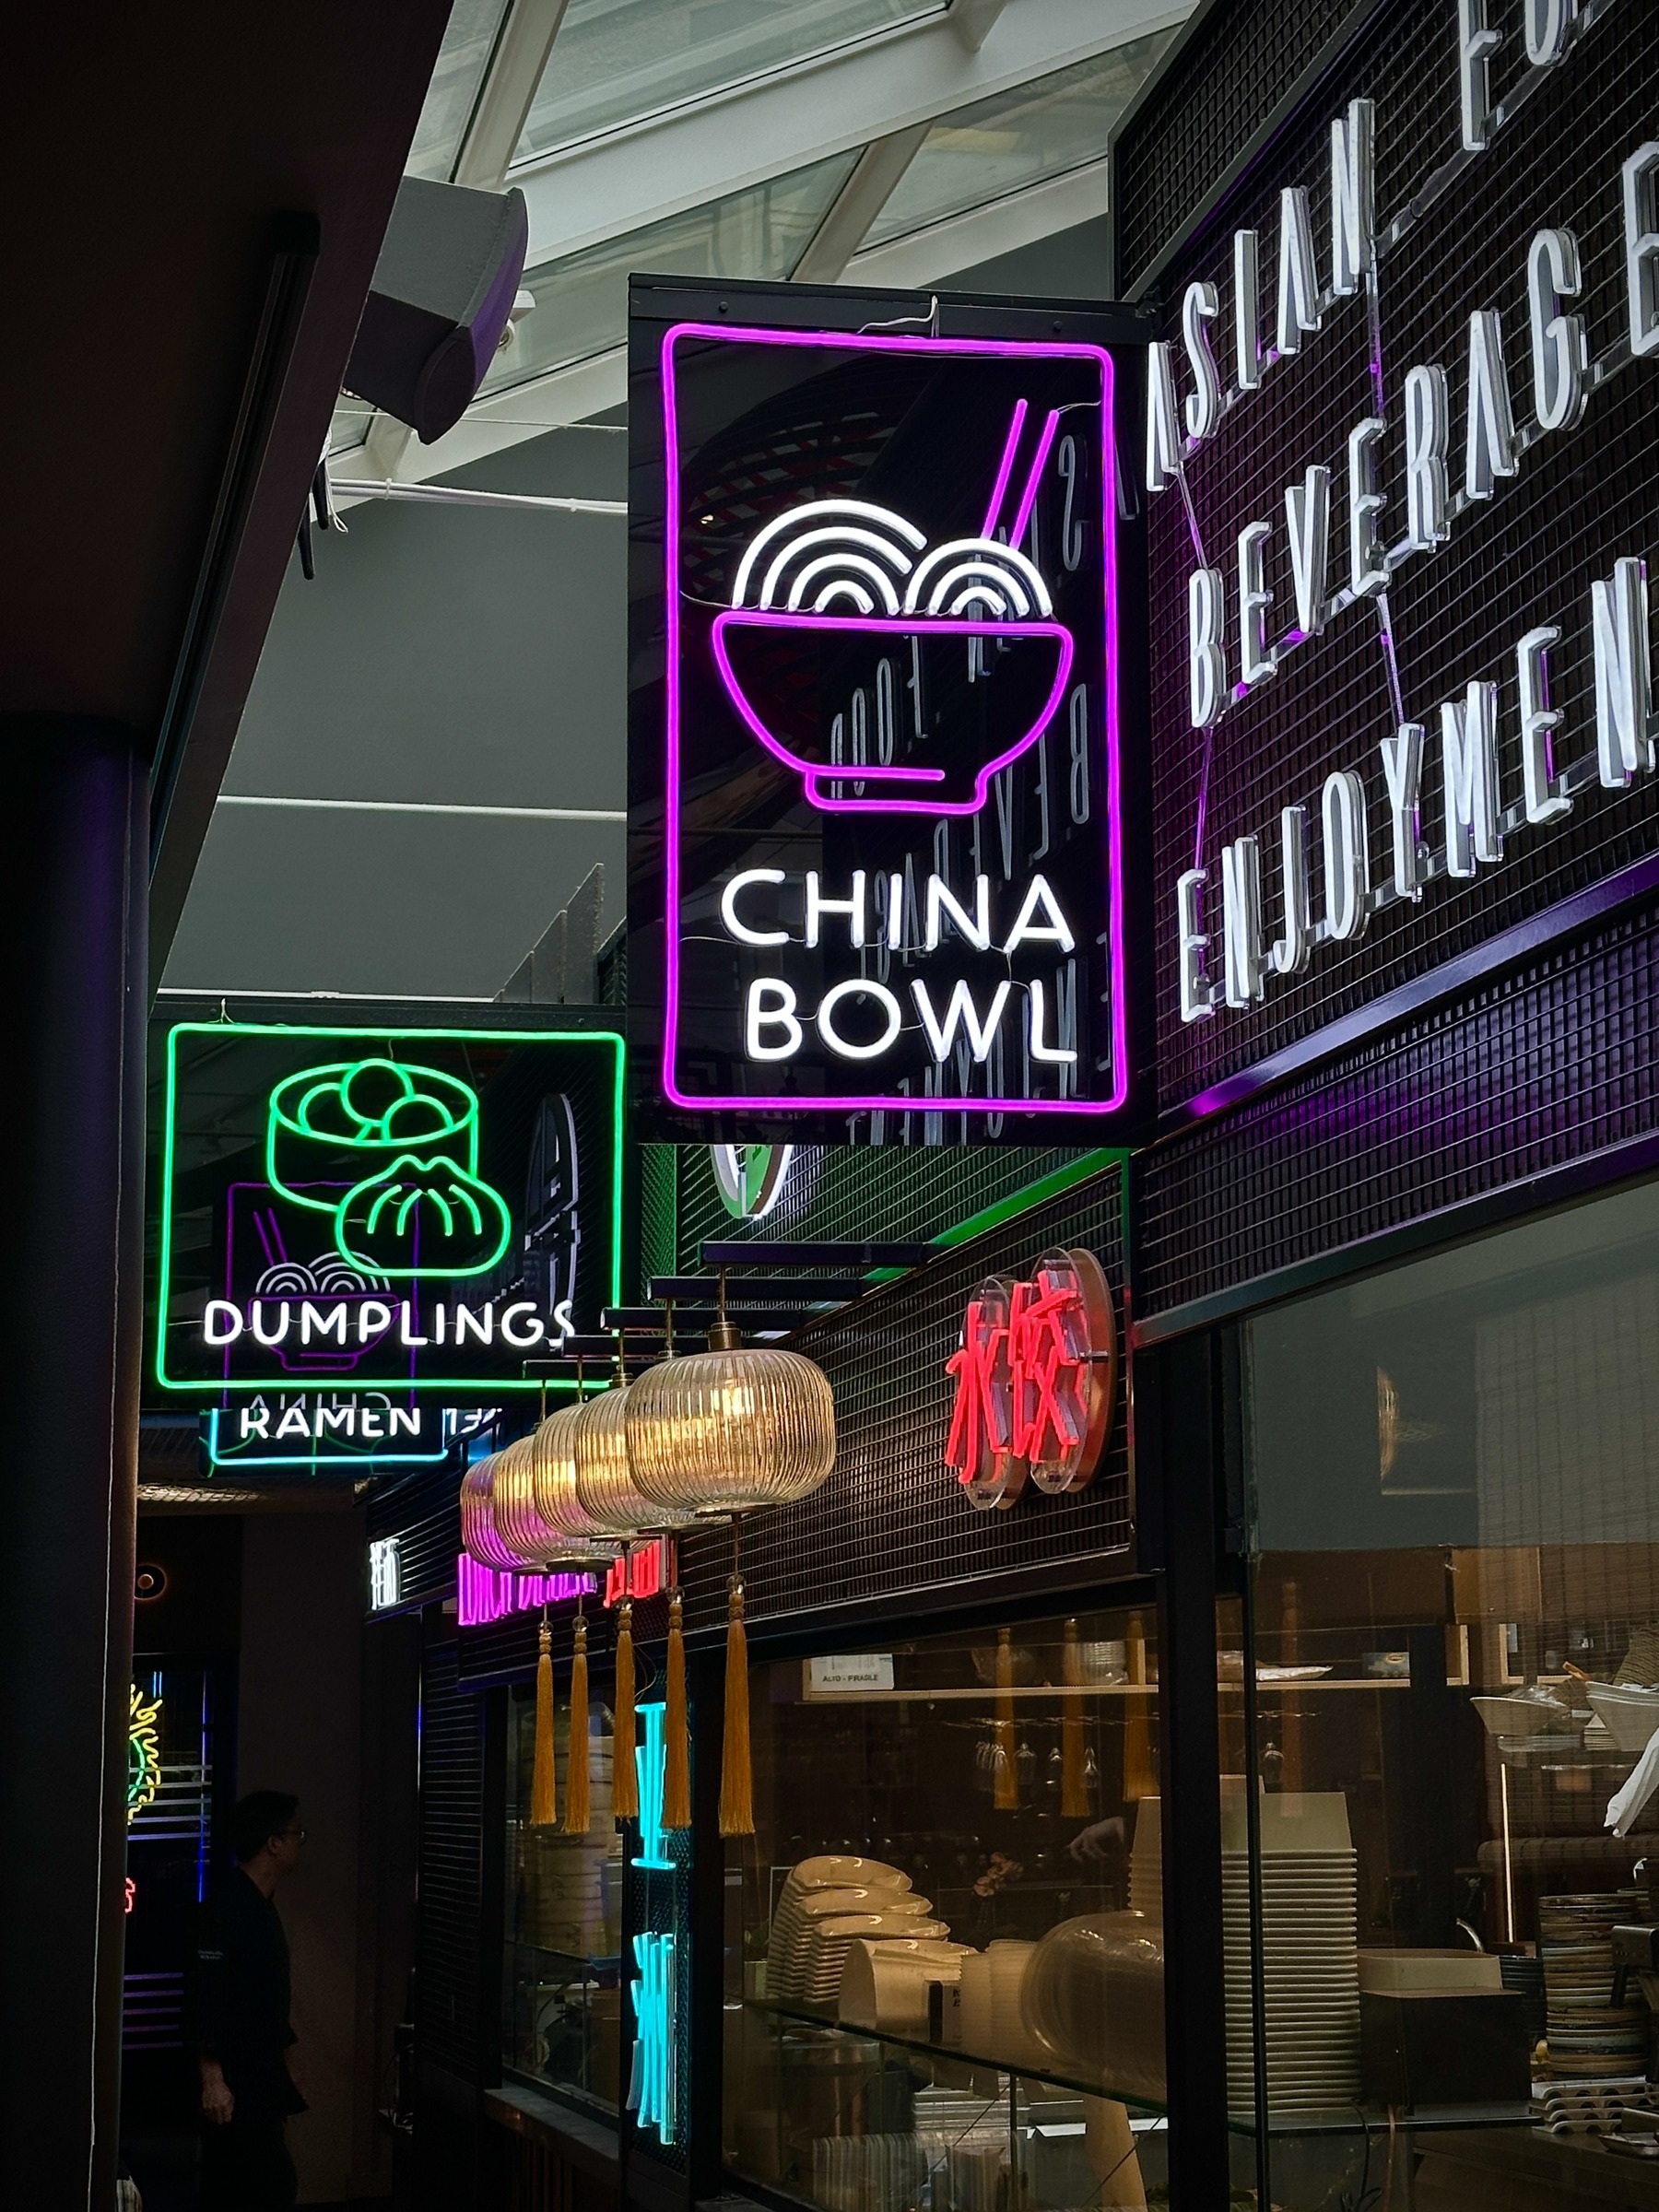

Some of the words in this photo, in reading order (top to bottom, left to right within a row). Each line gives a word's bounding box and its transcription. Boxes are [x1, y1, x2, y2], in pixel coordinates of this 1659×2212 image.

[1146, 97, 1377, 492] ASIAN
[1188, 140, 1659, 728] BEVERAGE
[1177, 556, 1655, 1023] ENJOYMEN
[720, 868, 1077, 953] CHINA
[745, 977, 1078, 1063] BOWL
[203, 1299, 576, 1348] DUMPLINGS
[240, 1407, 421, 1440] RAMEN
